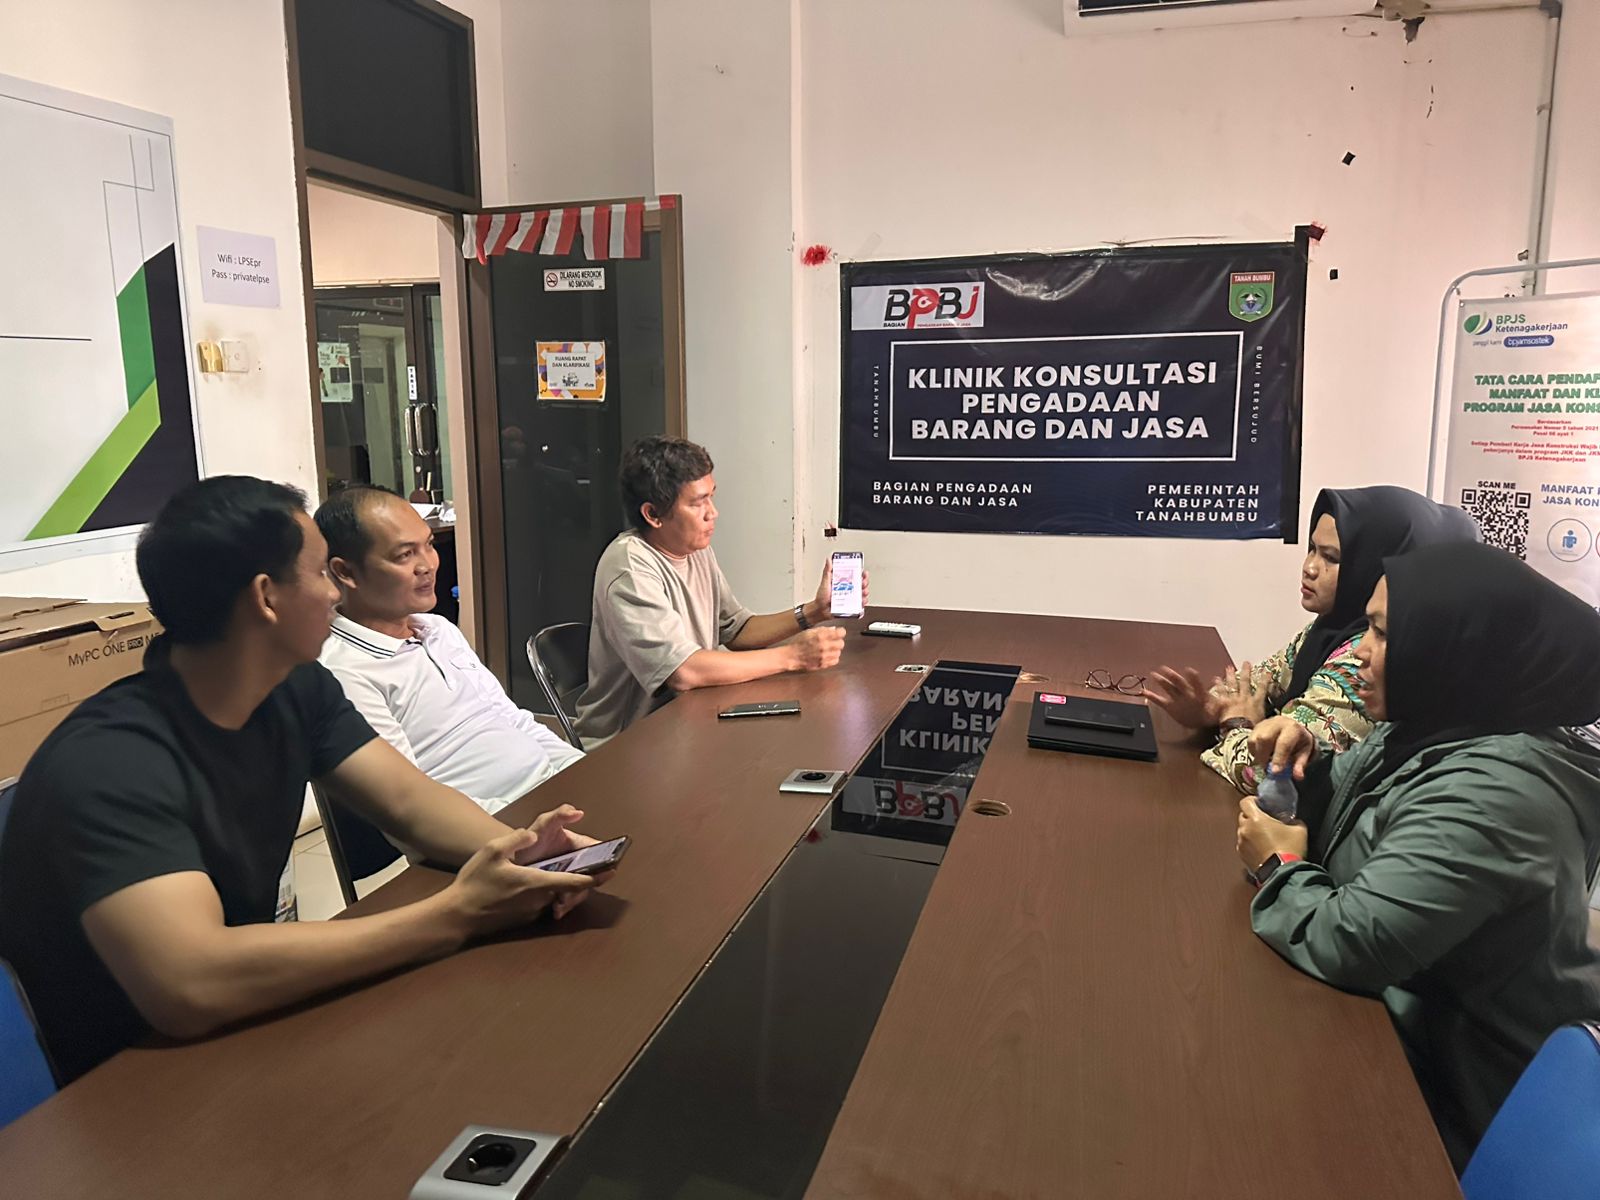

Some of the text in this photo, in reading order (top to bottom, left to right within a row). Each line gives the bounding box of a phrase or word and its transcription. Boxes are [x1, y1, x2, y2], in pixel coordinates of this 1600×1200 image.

[216, 253, 233, 264] Wifi
[238, 256, 262, 268] LPSEpr
[211, 268, 228, 279] Pass
[232, 273, 270, 285] privatelpse
[560, 270, 602, 280] DILARANG MEROKOK
[568, 280, 595, 288] NO SMOKING
[884, 286, 980, 329] BPBJ
[1496, 314, 1526, 325] BPJS
[1495, 323, 1568, 333] Ketenagakerjaan
[1254, 345, 1263, 375] BUMI
[908, 361, 1217, 389] KLINIK KONSULTASI
[1474, 375, 1505, 386] TATA
[1508, 374, 1544, 385] CARA
[1489, 388, 1550, 399] MANFAAT
[1552, 388, 1581, 399] DAN
[962, 390, 1160, 414] PENGADAAN
[1463, 402, 1525, 413] PROGRAM
[1527, 402, 1562, 413] JASA
[911, 416, 1209, 440] BARANG DAN JASA
[873, 481, 1032, 494] BAGIAN PENGADAAN
[1147, 484, 1260, 495] PEMERINTAH
[1477, 480, 1501, 489] SCAN
[1541, 483, 1594, 495] MANFAAT
[873, 494, 1018, 507] BARANG DAN JASA
[1154, 497, 1259, 508] KABUPATEN
[1542, 495, 1572, 505] JASA
[1136, 510, 1258, 522] TANAHBUMBU
[68, 648, 100, 667] MyPC
[102, 641, 126, 657] ONE
[128, 637, 143, 649] PRO
